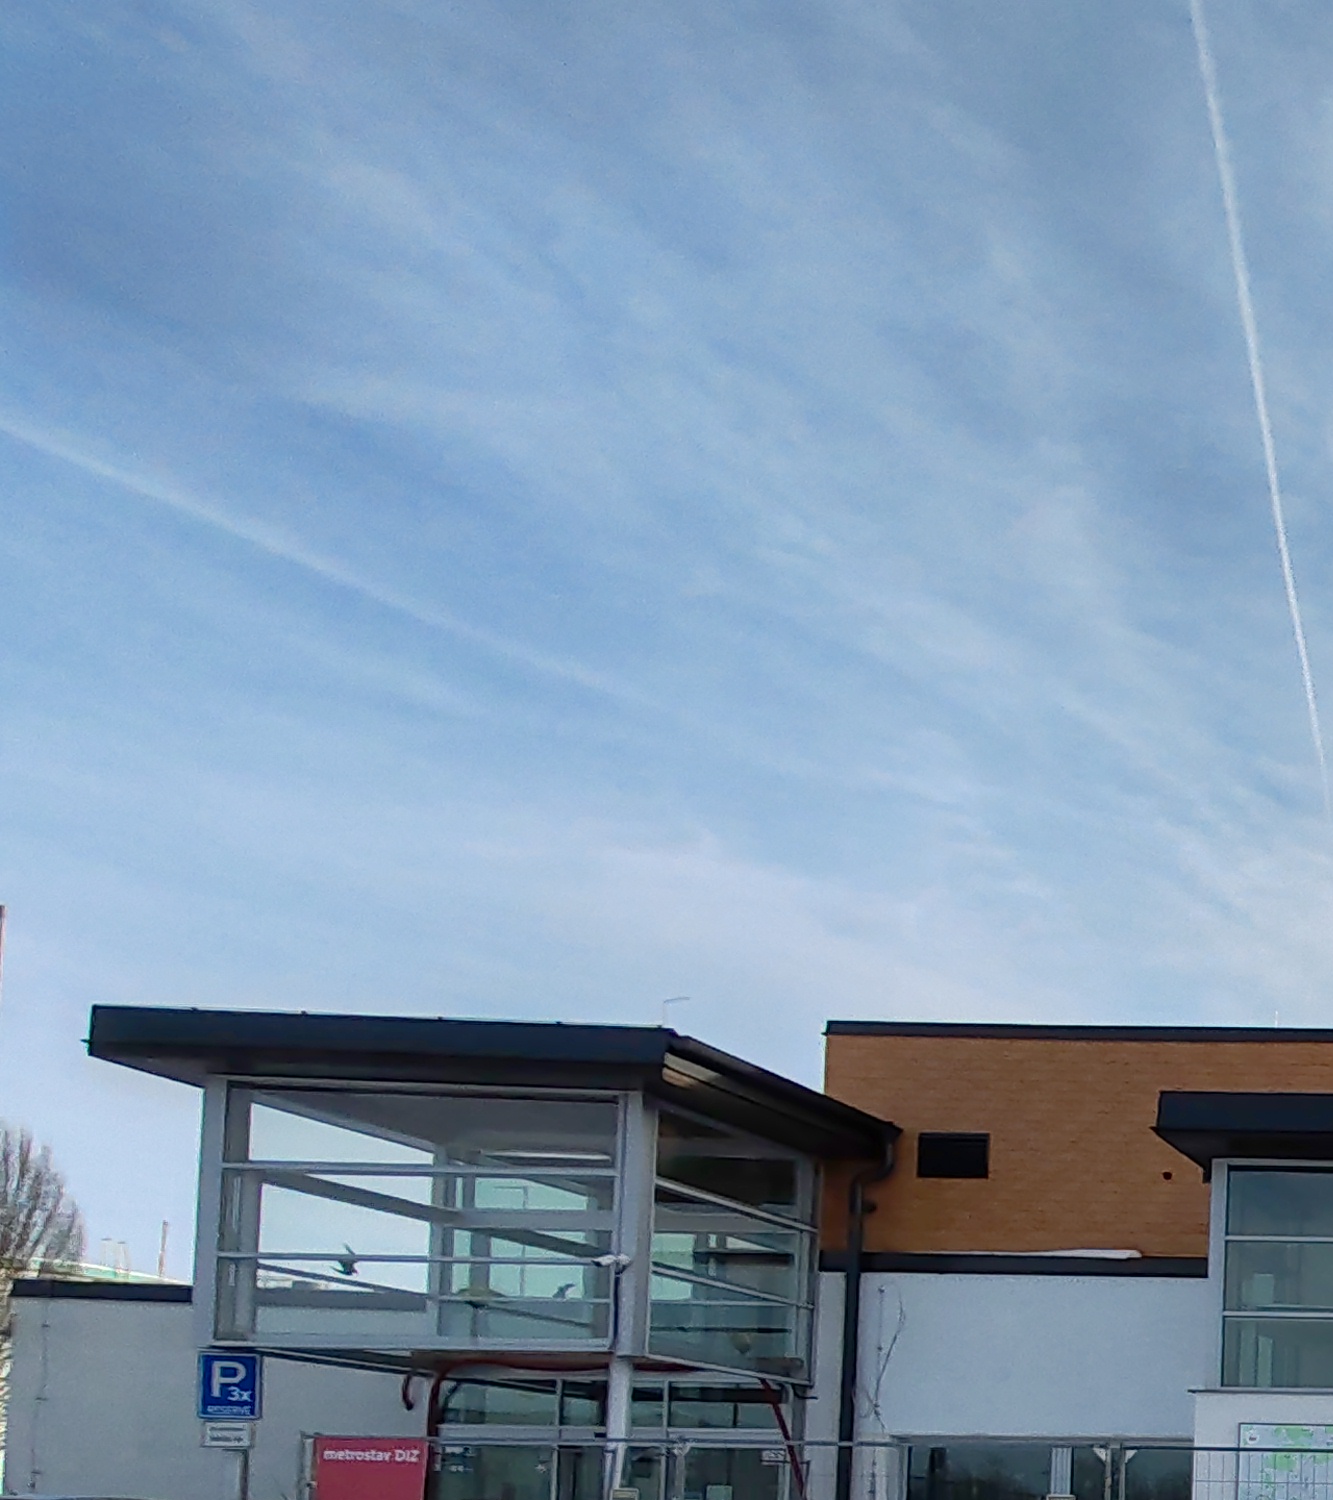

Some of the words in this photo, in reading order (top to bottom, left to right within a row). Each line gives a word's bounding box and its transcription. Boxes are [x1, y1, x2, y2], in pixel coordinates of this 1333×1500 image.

[211, 1361, 247, 1398] P
[227, 1386, 253, 1402] 3x
[323, 1449, 391, 1462] metrostav
[394, 1449, 420, 1463] DIZ
